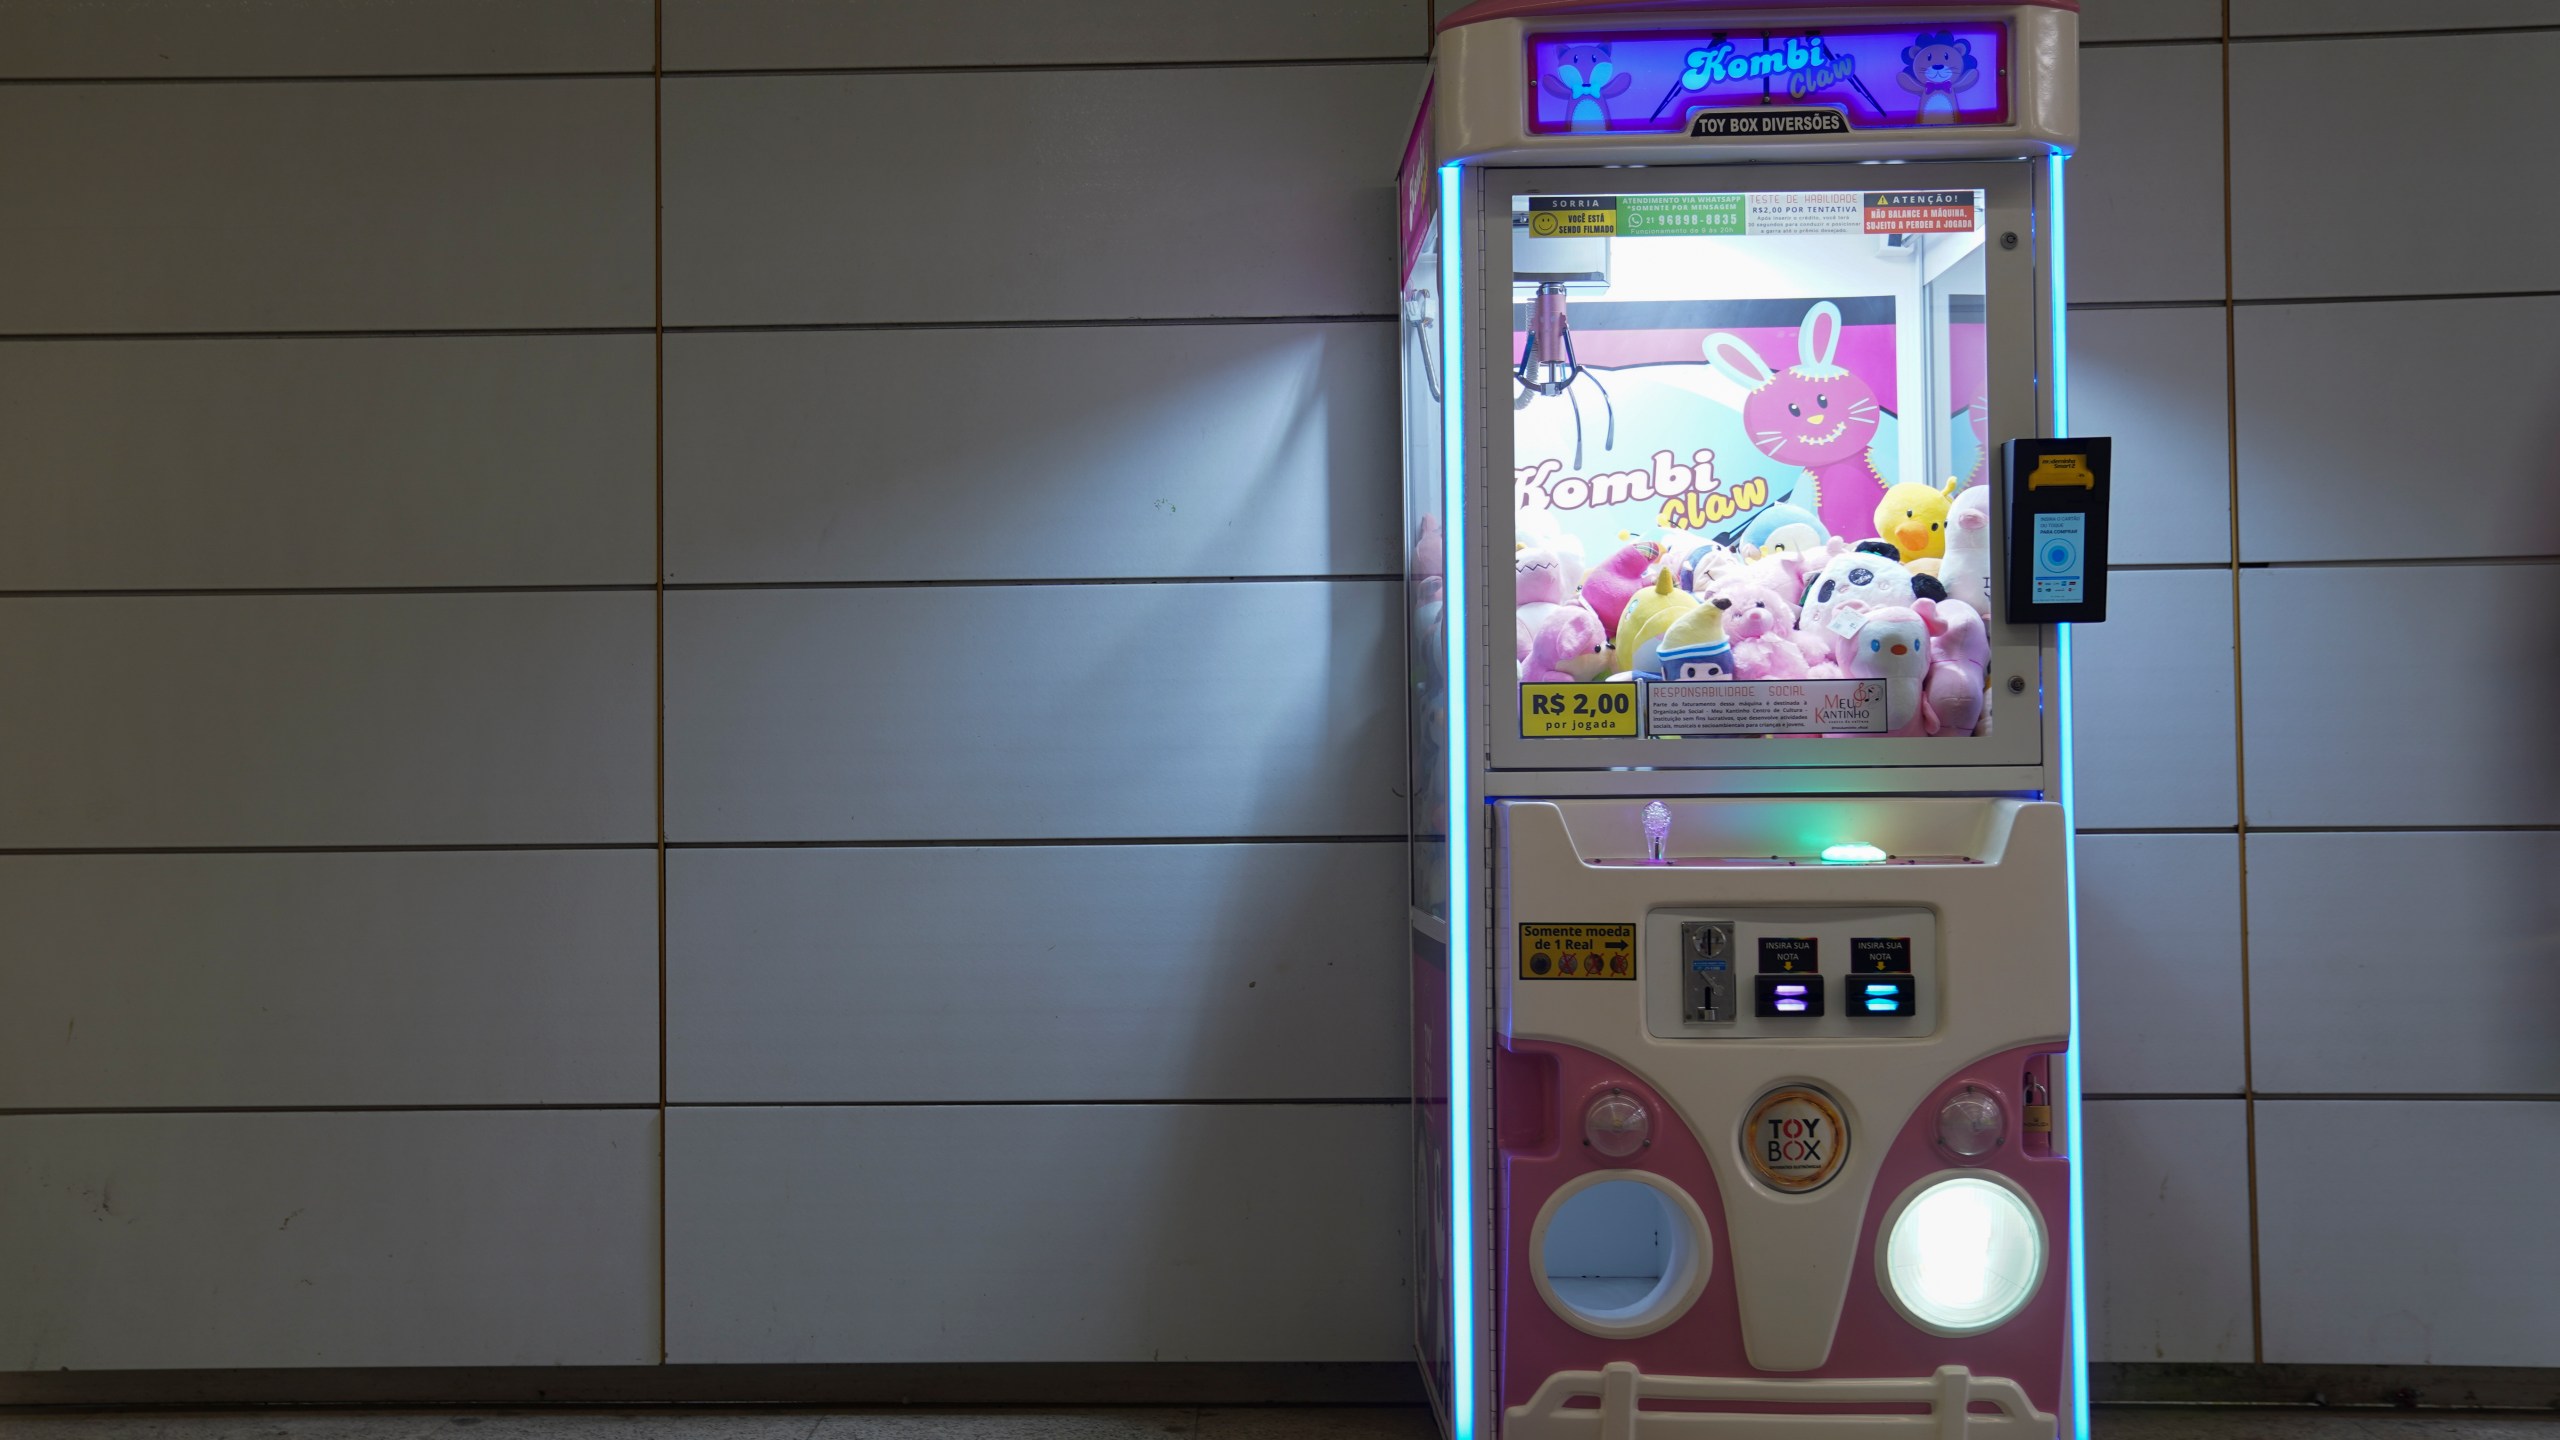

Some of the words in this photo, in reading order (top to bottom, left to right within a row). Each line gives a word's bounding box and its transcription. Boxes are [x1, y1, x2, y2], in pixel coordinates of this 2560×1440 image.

[1681, 37, 1825, 90] Kombi
[1790, 57, 1853, 98] Claw
[1700, 118, 1726, 132] TOY
[1731, 118, 1758, 132] BOX
[1763, 113, 1839, 132] DIVERSÕES
[1750, 195, 1780, 204] TESTE
[1787, 195, 1798, 203] DE
[1805, 194, 1857, 203] HABILIDADE
[1893, 194, 1958, 206] ATENÇÃO!
[1568, 213, 1586, 222] VOCÊ
[1588, 213, 1604, 222] ESTÁ
[1871, 208, 1886, 218] NÃO
[1888, 209, 1921, 218] BALANCE
[1923, 210, 1928, 218] A
[1559, 226, 1581, 234] SENDO
[1584, 225, 1613, 233] FILMADO
[1866, 221, 1896, 230] SUJEITO
[1906, 221, 1933, 229] PERDER
[1936, 220, 1941, 228] A
[1943, 220, 1972, 228] JOGADA
[1657, 477, 1769, 531] Claw
[1653, 686, 1755, 698] RESPONSABILIDADE
[1769, 686, 1805, 697] SOCIAL
[1532, 693, 1565, 716] R$
[1573, 693, 1629, 717] 2,00
[1546, 721, 1567, 731] por
[1572, 720, 1616, 730] jogada
[1525, 926, 1582, 936] Somente
[1586, 926, 1630, 936] moeda
[1535, 939, 1550, 949] de
[1555, 940, 1560, 949] 1
[1566, 939, 1592, 949] Real
[1768, 1119, 1820, 1139] TOY
[1769, 1140, 1821, 1161] BOX
